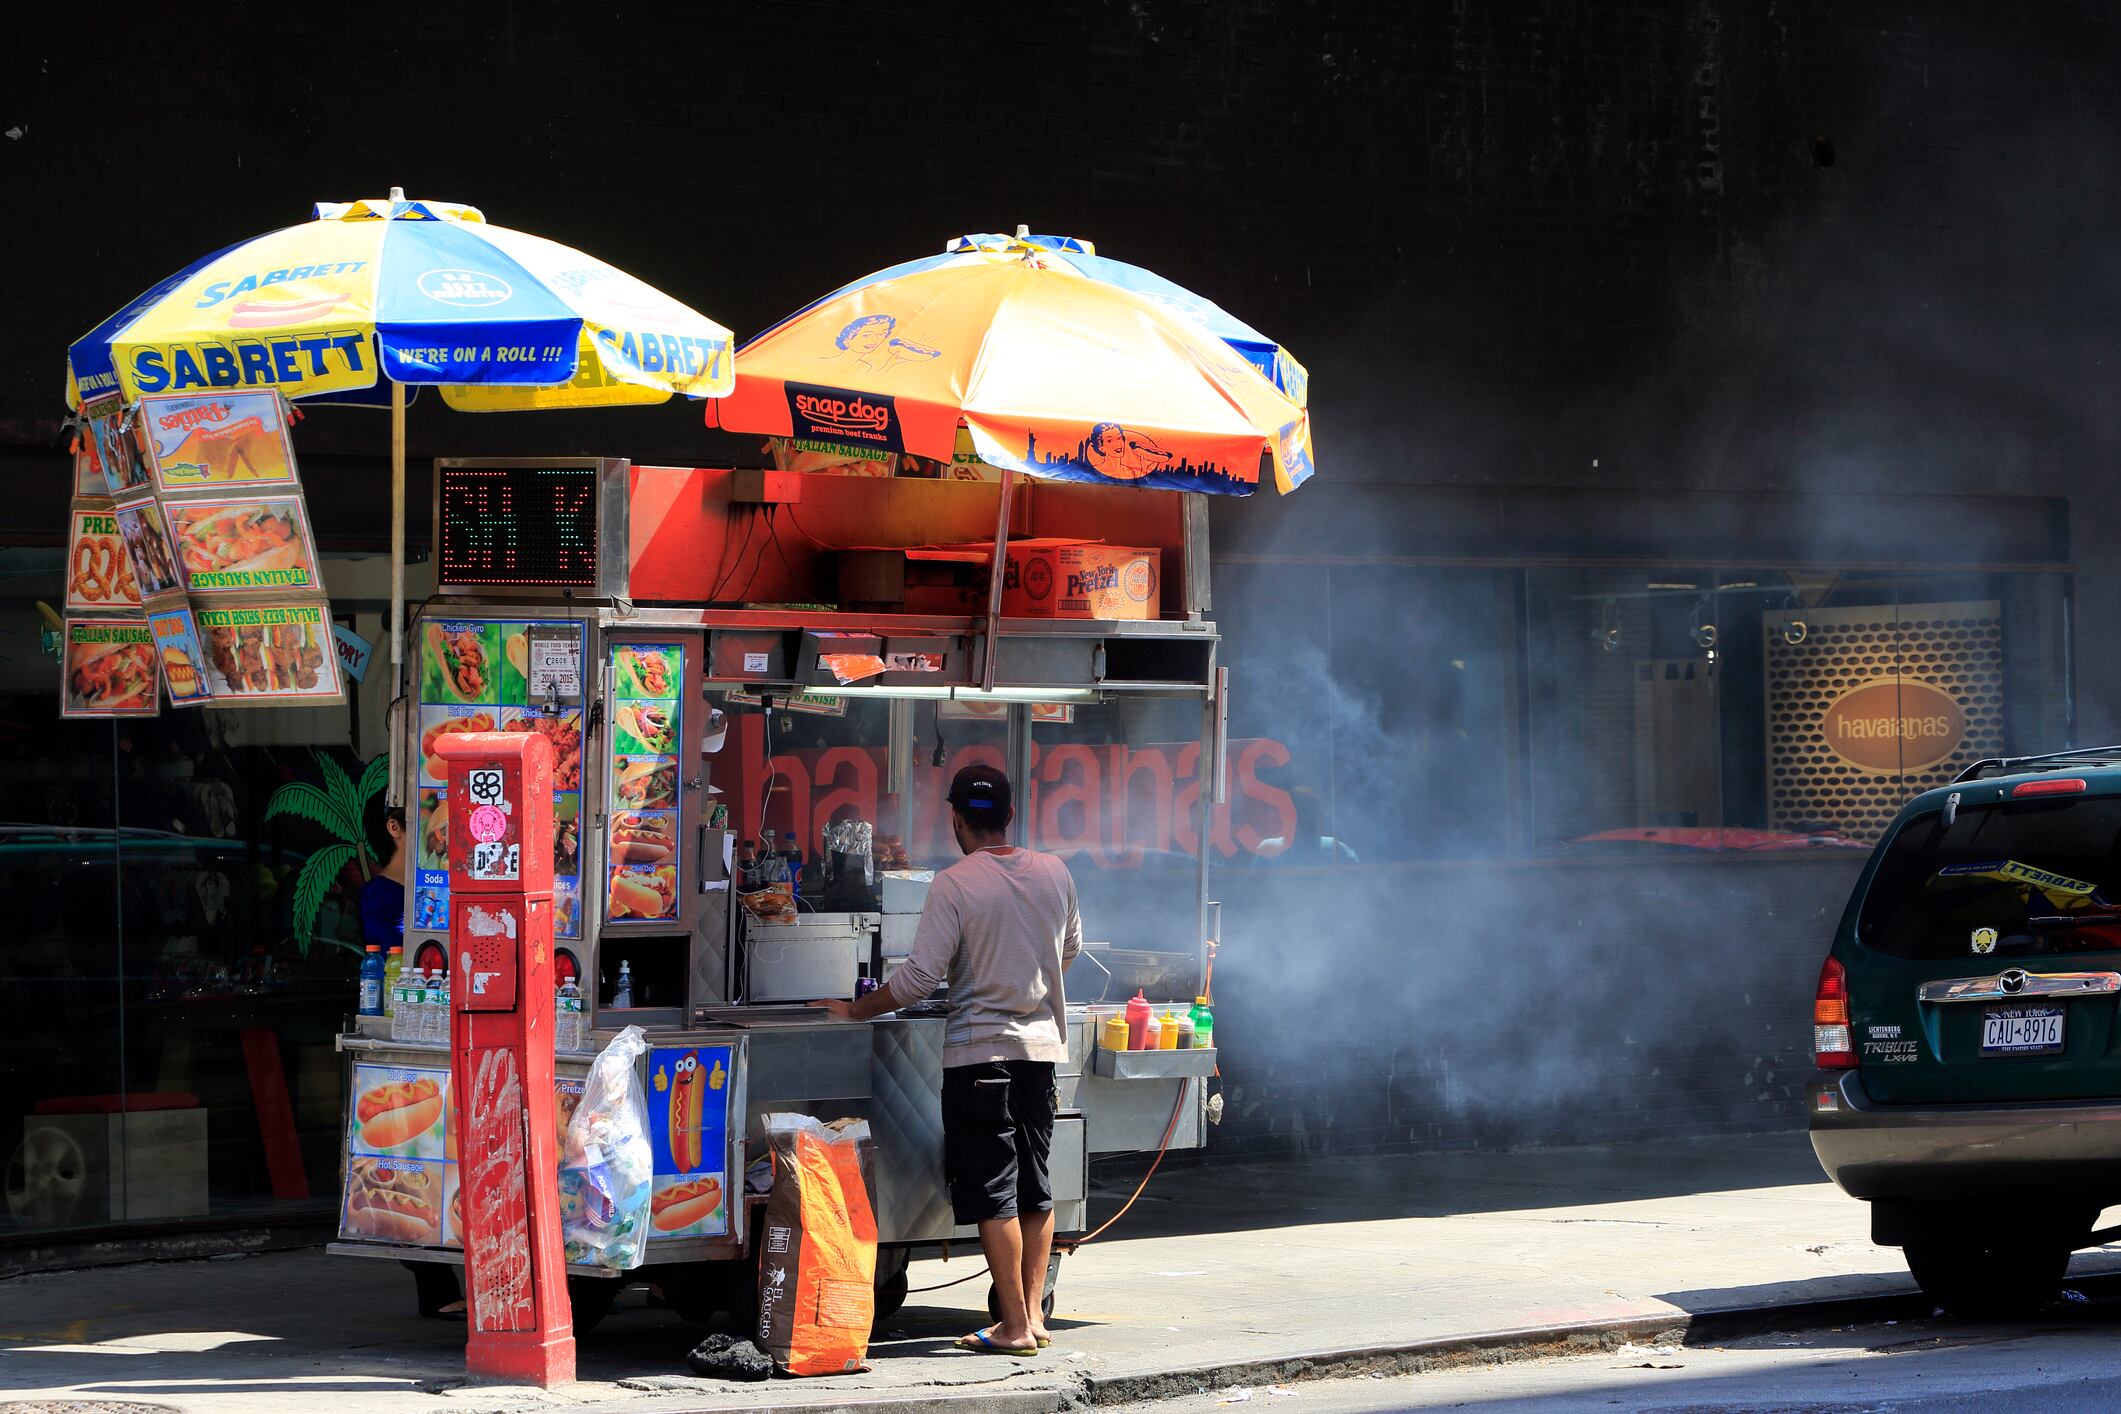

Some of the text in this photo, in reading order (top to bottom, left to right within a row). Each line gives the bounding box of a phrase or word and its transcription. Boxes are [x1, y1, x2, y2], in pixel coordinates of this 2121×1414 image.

[194, 261, 368, 309] SABRETT
[130, 329, 365, 393] SABRETT
[399, 347, 448, 364] WE'RE
[454, 347, 479, 363] ON
[481, 347, 491, 362] A
[497, 347, 537, 363] ROLL
[597, 324, 727, 380] SABRETT
[159, 402, 230, 432] Patties
[796, 394, 888, 430] snap dog
[811, 424, 888, 442] premium beef franks
[839, 443, 889, 462] SAUSAGE
[191, 567, 309, 588] ITALIAN SAUSAGE
[1080, 563, 1116, 580] New York
[1067, 567, 1119, 597] Pretzel
[262, 608, 286, 624] BEEF
[288, 606, 321, 624] HALAL
[73, 626, 111, 644] ITALIAN
[442, 624, 484, 634] Chicken Gyro
[803, 694, 836, 706] KNISH
[1838, 714, 1950, 740] havaianas
[425, 873, 443, 885] Soda
[2004, 1008, 2046, 1018] NEW YORK
[1989, 1018, 2056, 1044] CAU 8916
[1864, 1041, 1918, 1054] TRIBUTE
[388, 1070, 417, 1084] Hot Dog
[378, 1159, 424, 1174] Hot Sausage
[772, 1287, 783, 1303] EL
[762, 1287, 774, 1339] GAUCHO
